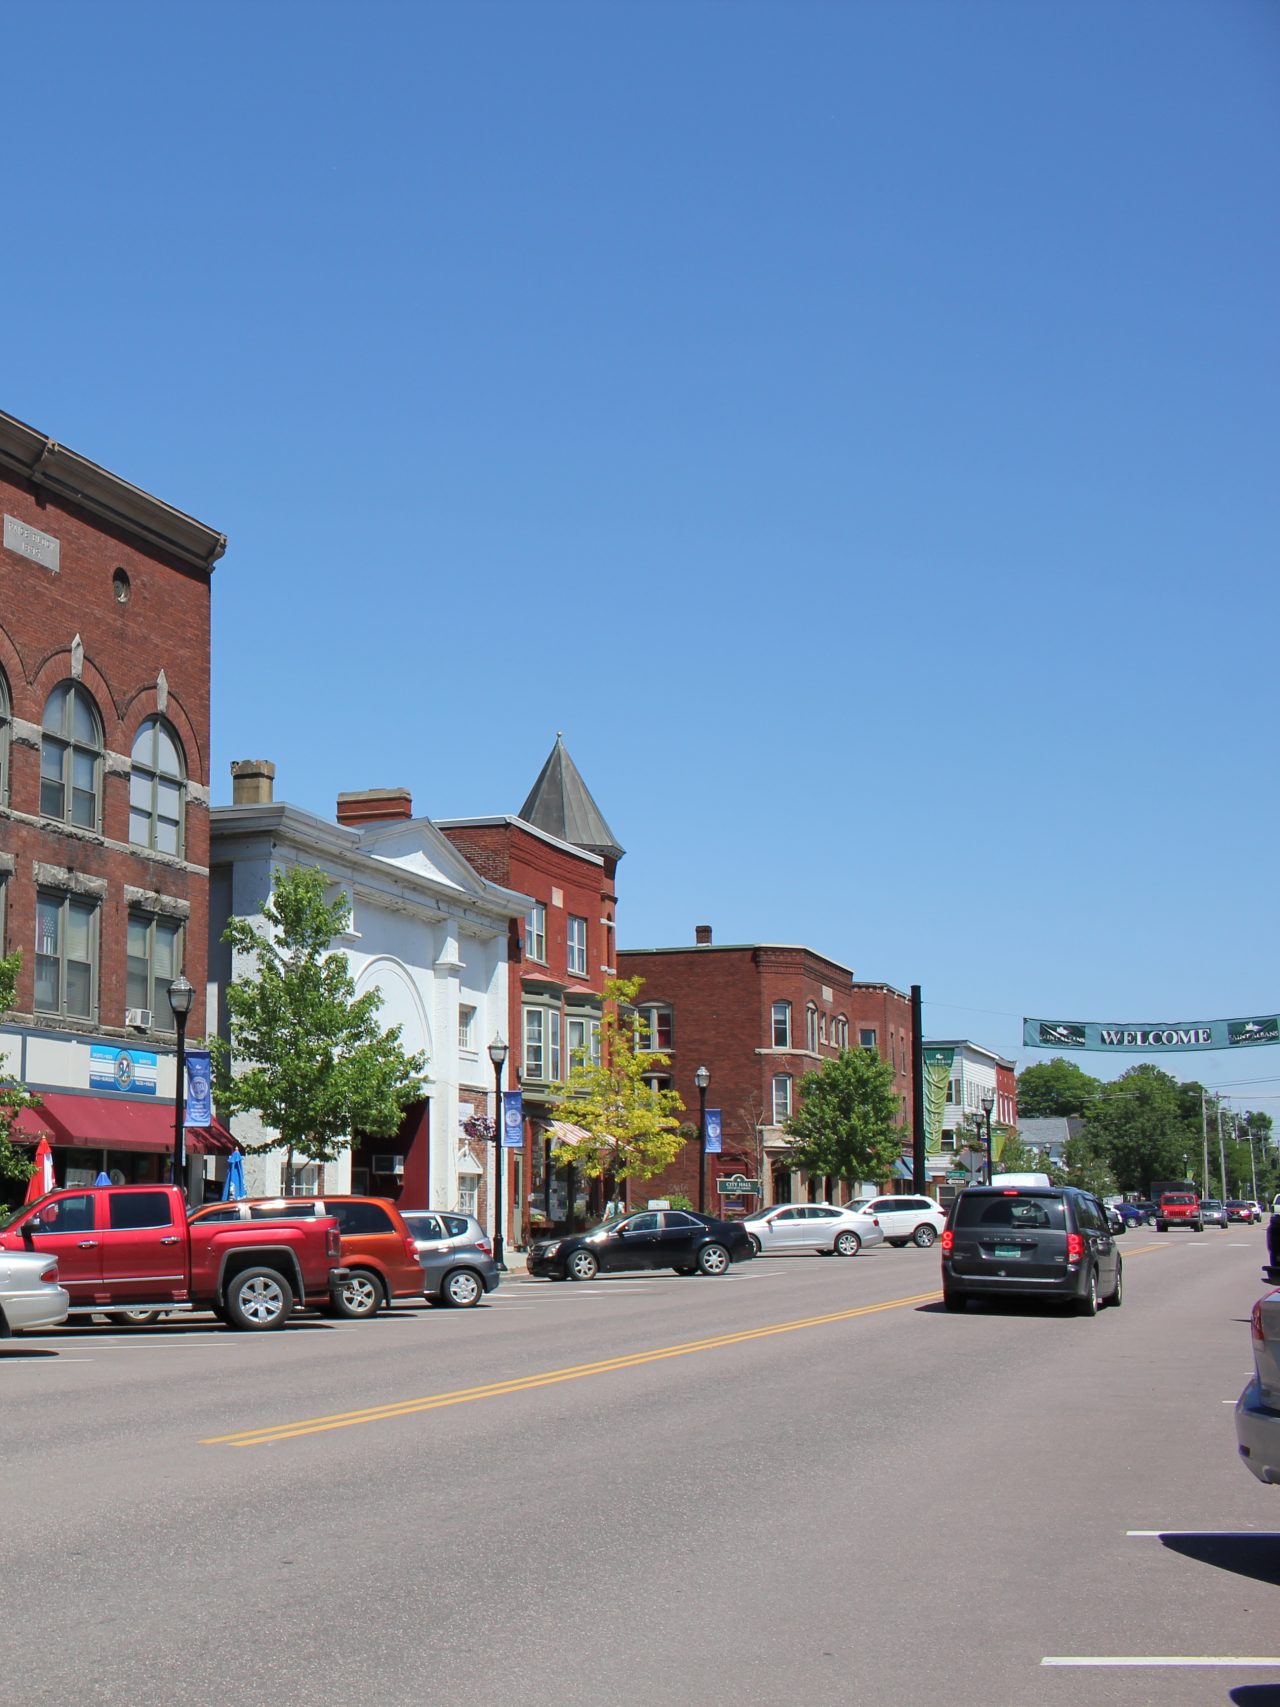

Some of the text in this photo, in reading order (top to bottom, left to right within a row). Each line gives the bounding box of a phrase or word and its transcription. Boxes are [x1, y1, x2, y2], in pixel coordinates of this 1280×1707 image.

[1101, 1028, 1211, 1046] WELCOME
[1229, 1033, 1250, 1042] SAINT
[1252, 1030, 1279, 1040] ALBANS
